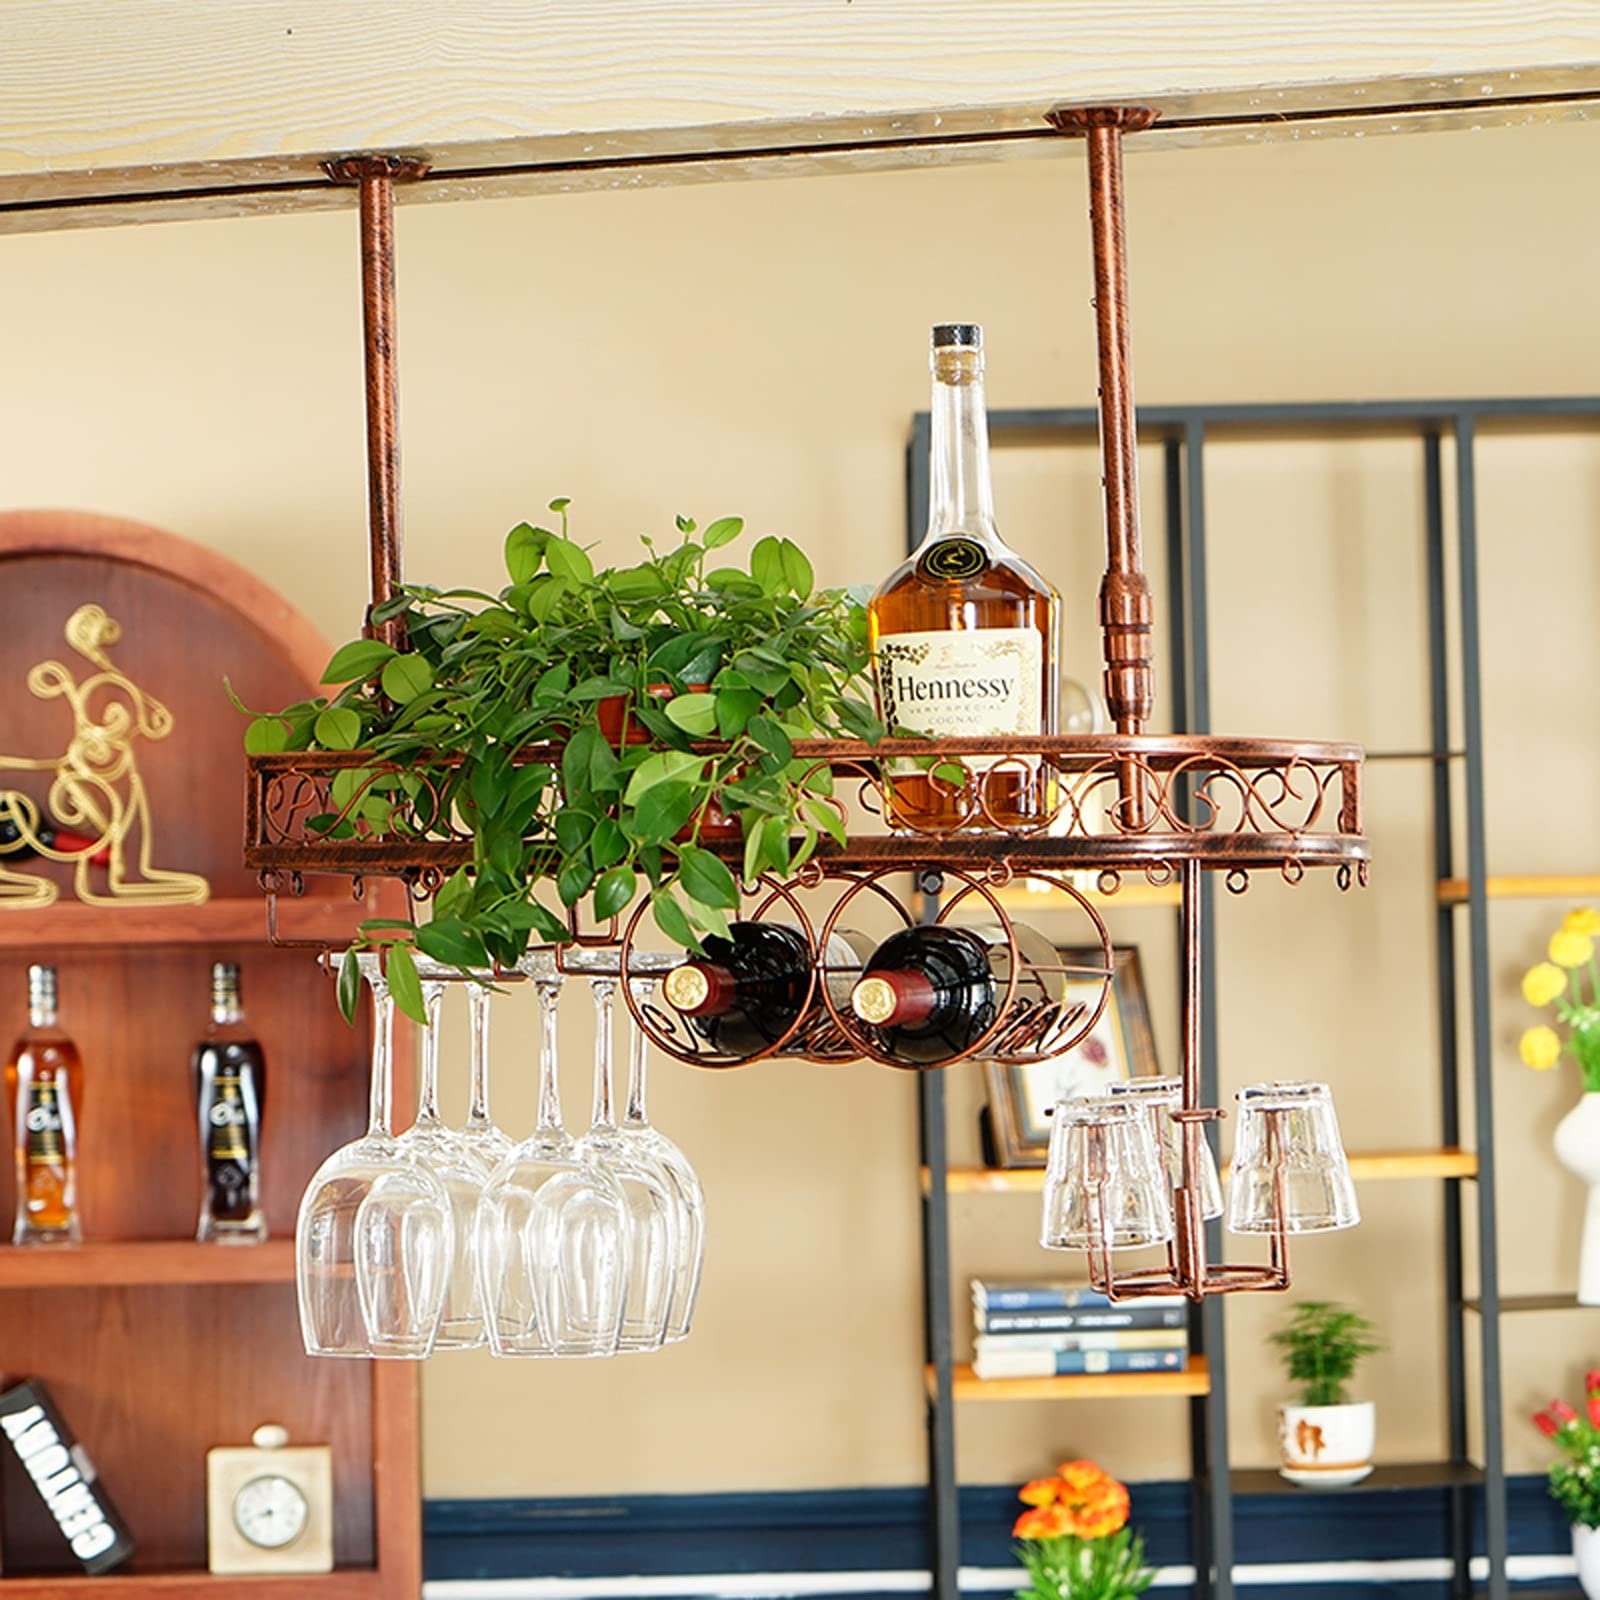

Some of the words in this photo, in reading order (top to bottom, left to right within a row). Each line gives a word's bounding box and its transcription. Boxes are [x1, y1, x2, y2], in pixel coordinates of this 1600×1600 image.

[897, 675, 1015, 703] Hennessy
[945, 702, 1003, 713] SPECIAL
[927, 714, 982, 725] COGNAC
[0, 1404, 116, 1560] CENTURY
